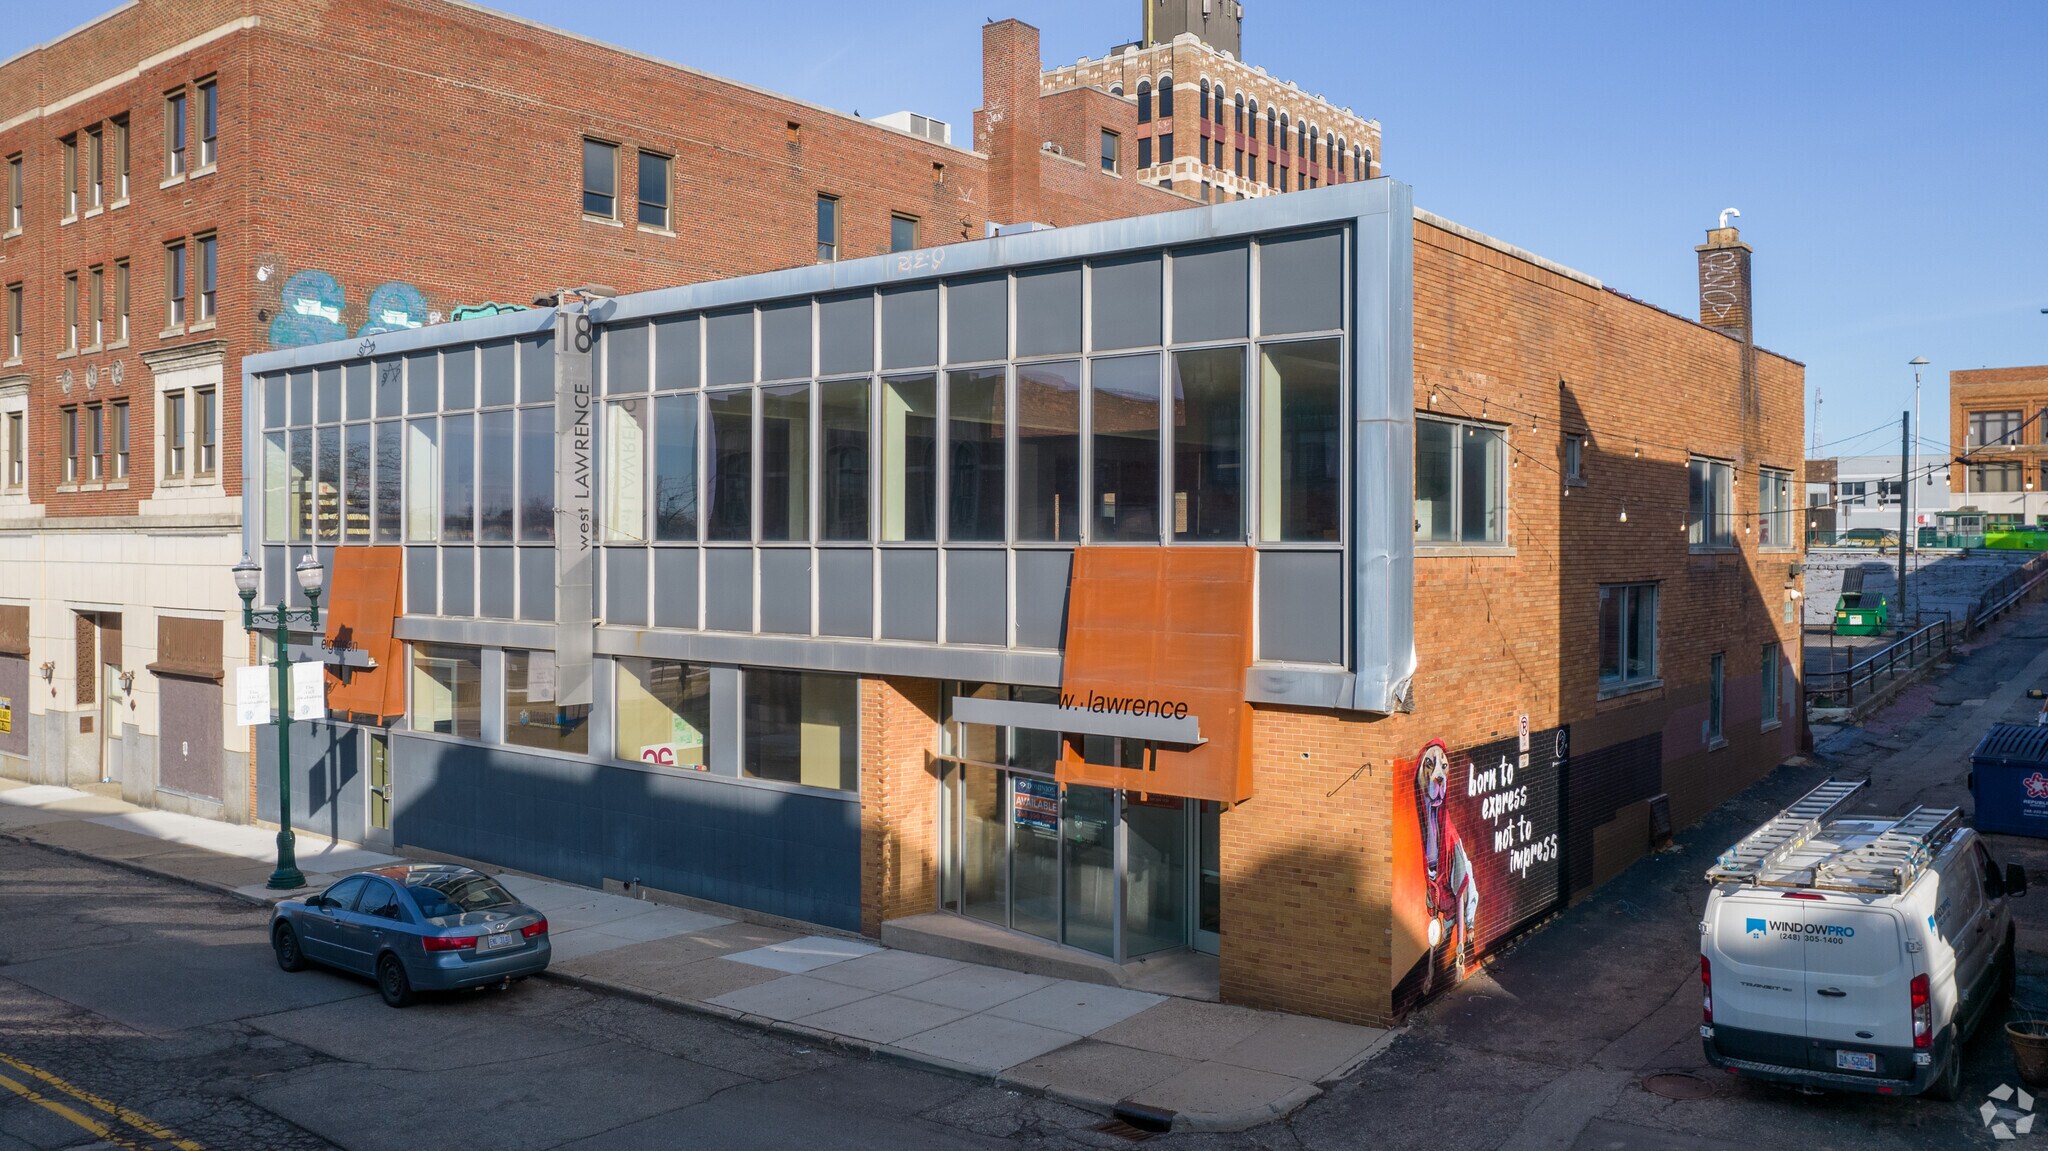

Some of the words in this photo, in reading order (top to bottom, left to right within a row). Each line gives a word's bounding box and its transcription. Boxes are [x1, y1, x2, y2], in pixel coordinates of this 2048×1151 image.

[559, 312, 592, 353] 18
[575, 383, 589, 498] LAWRENCE
[578, 507, 589, 551] west
[1087, 690, 1188, 720] lawrence
[1468, 763, 1497, 797] born
[1500, 755, 1514, 787] to
[1016, 796, 1057, 812] AVAILABLE
[1482, 785, 1527, 826] express
[1494, 818, 1515, 853] not
[1517, 814, 1532, 842] to
[1510, 833, 1558, 879] impress
[1769, 920, 1855, 937] WINDOWPRO
[1779, 933, 1800, 942] (248)
[1804, 935, 1844, 945] 305-1400
